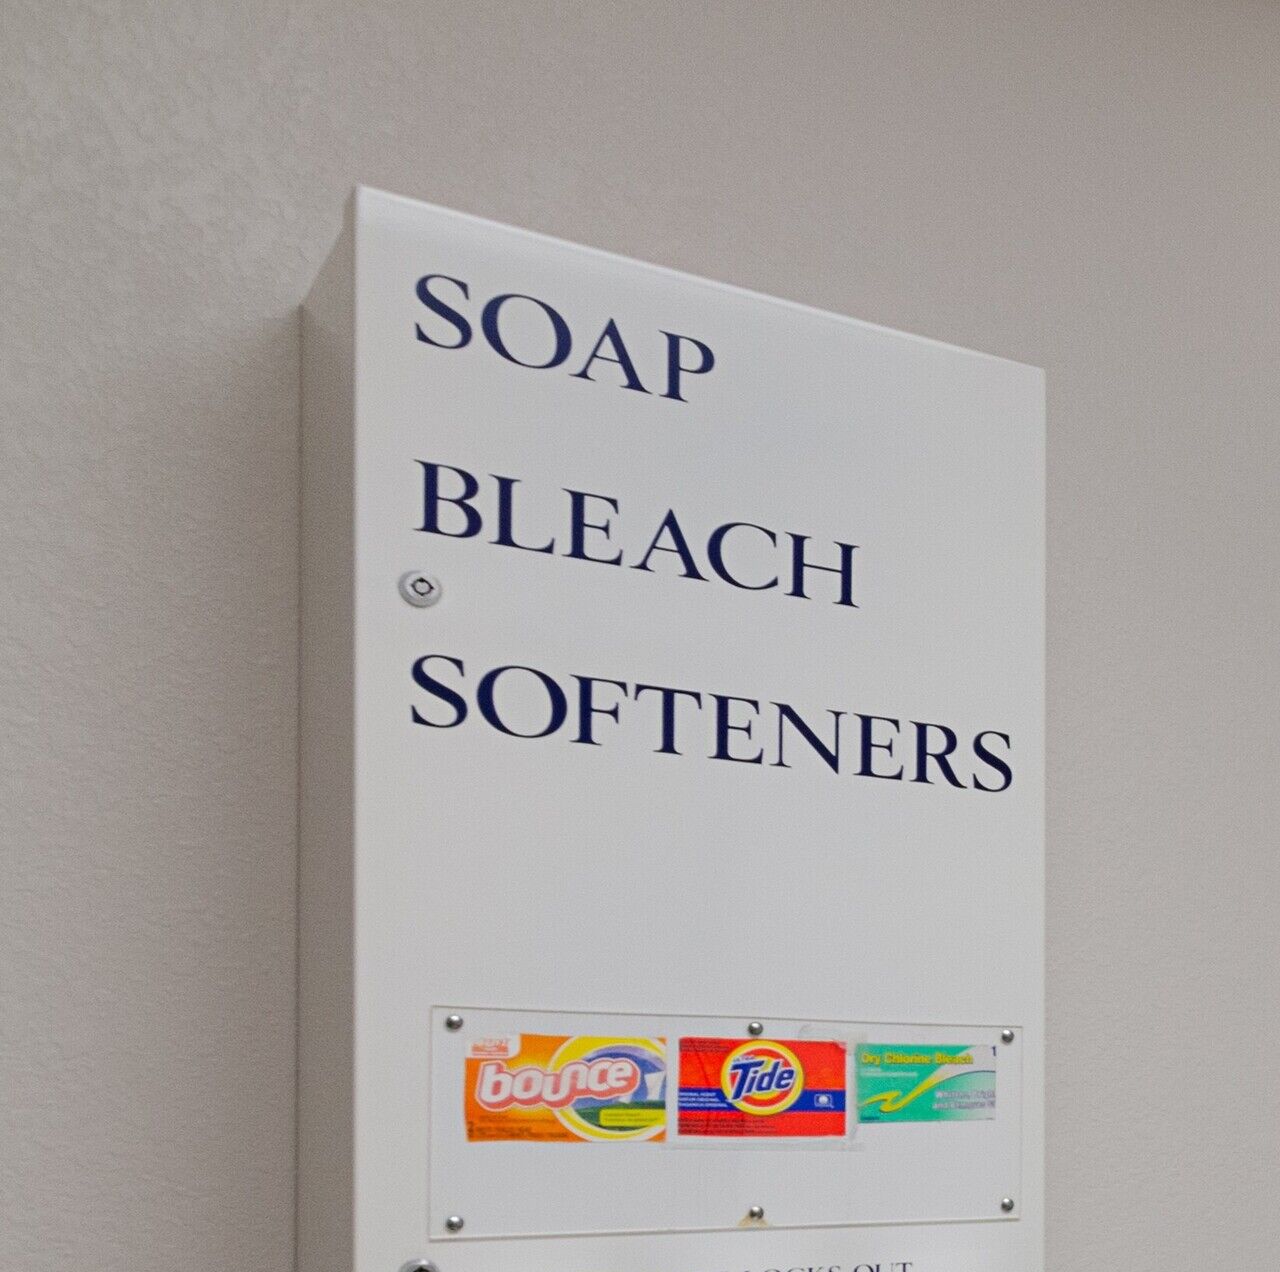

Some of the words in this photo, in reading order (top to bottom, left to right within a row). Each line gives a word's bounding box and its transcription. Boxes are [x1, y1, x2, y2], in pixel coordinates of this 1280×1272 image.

[415, 274, 715, 403] SOAP
[413, 459, 860, 608] BLEACH
[410, 655, 1014, 793] SOFTENERS
[478, 1060, 638, 1109] bounce
[731, 1060, 795, 1100] Tide
